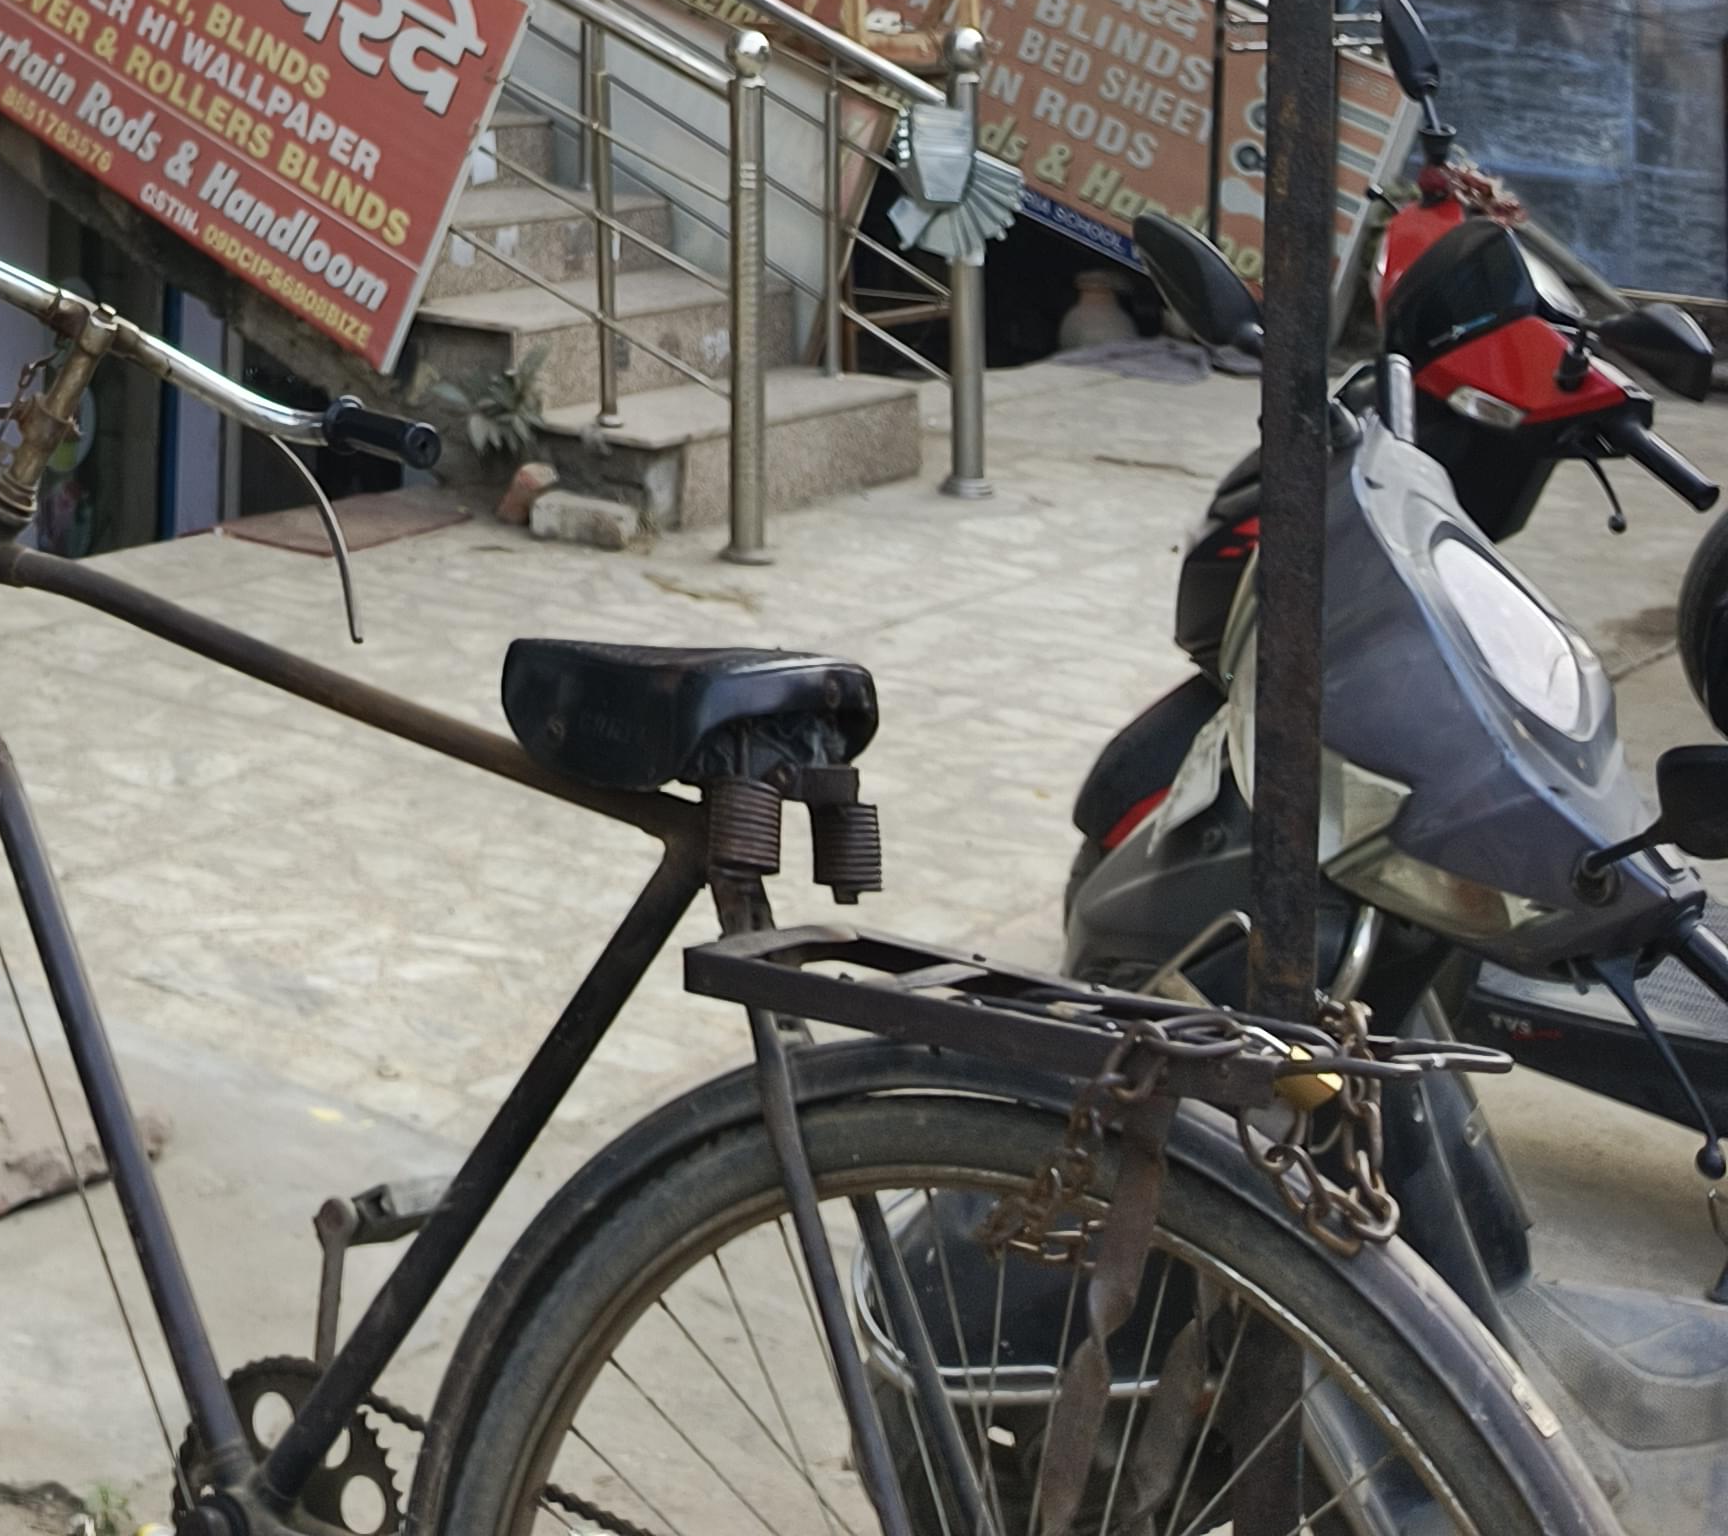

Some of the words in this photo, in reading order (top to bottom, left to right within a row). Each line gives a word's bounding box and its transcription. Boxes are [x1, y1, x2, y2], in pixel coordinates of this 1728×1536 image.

[136, 6, 178, 51] HI
[180, 29, 382, 182] WALLPAPER
[205, 2, 332, 101] BLINDS
[1016, 27, 1092, 88] BED
[92, 25, 119, 65] &
[123, 43, 277, 161] ROLLERS
[276, 139, 412, 249] BLINDS
[1032, 86, 1161, 172] RODS
[1034, 141, 1075, 191] &
[75, 80, 164, 163] Rods
[164, 139, 201, 188] &
[197, 160, 390, 314] Handloom
